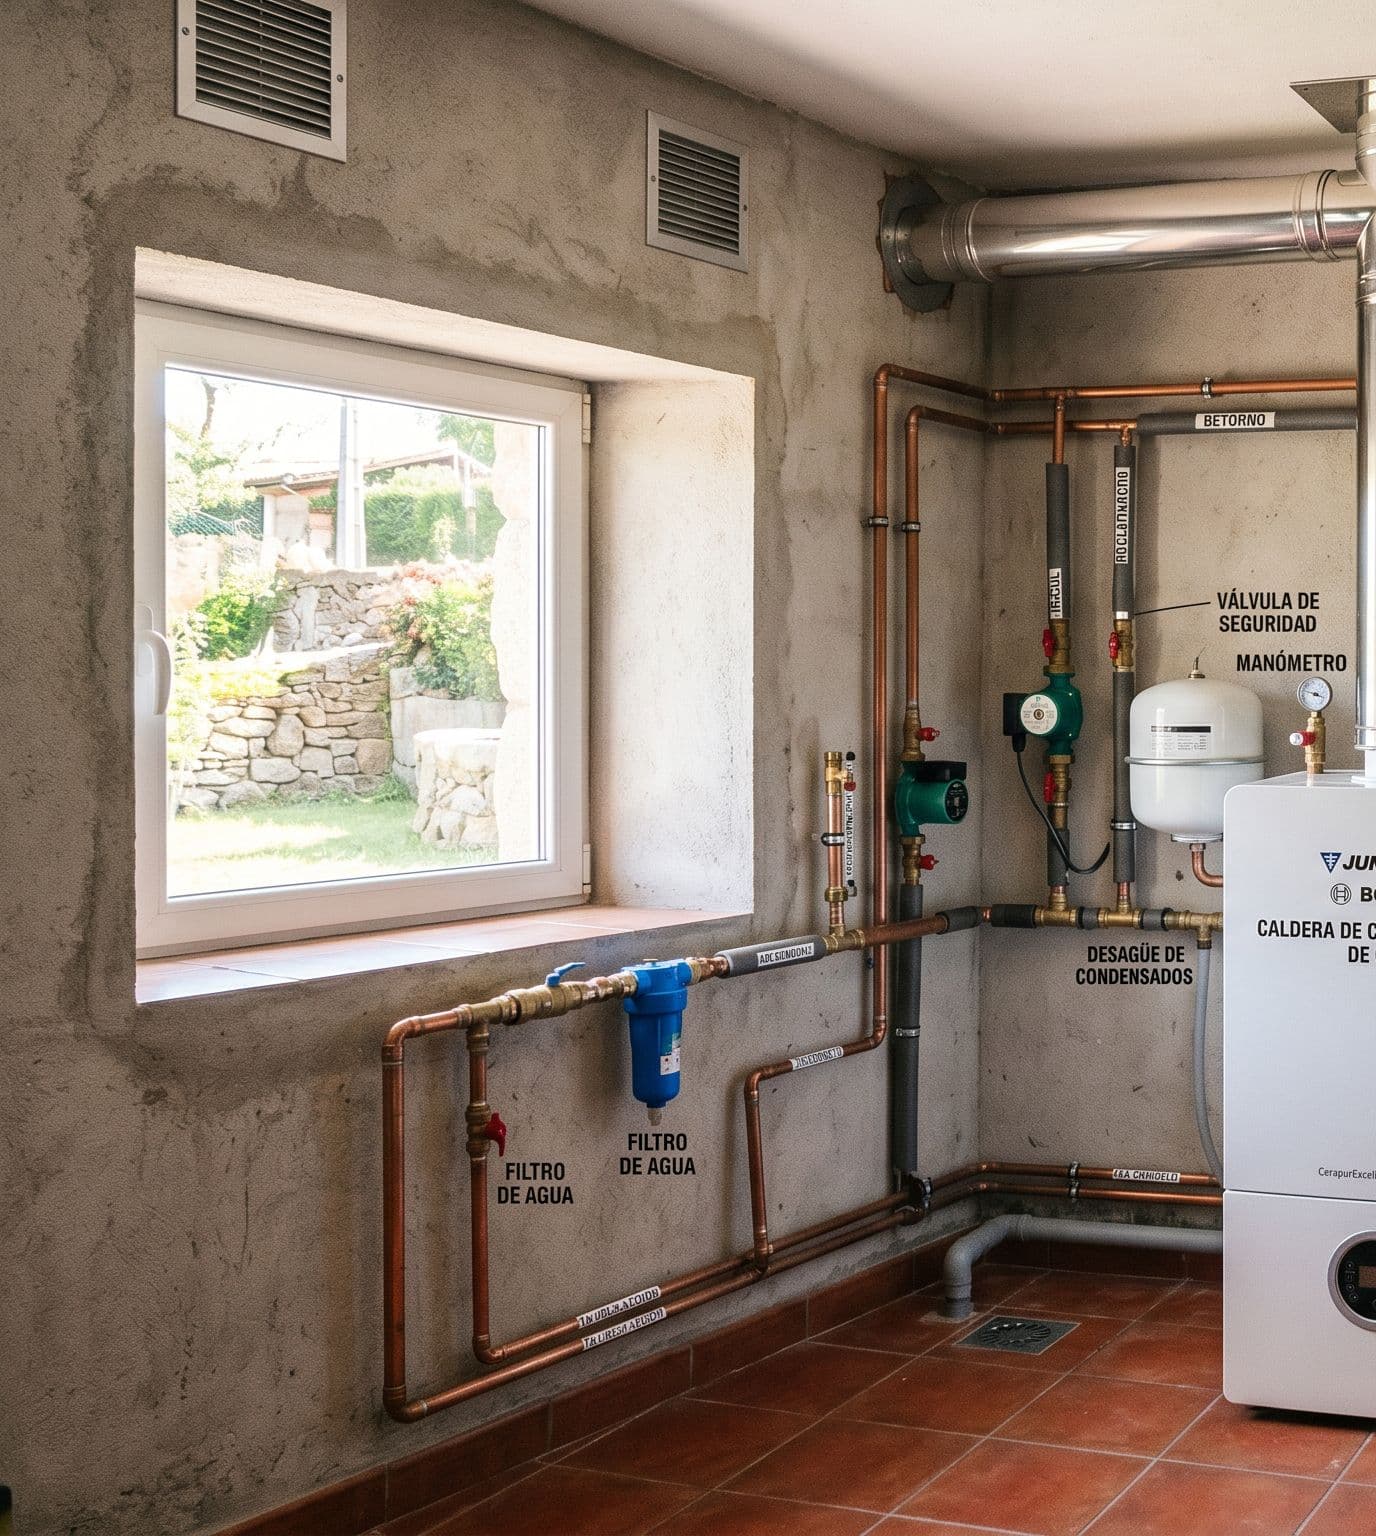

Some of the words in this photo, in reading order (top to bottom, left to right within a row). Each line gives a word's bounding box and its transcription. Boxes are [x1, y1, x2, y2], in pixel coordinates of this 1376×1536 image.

[1258, 920, 1334, 938] CALDERA
[1341, 922, 1361, 939] DE
[1349, 946, 1369, 963] DE
